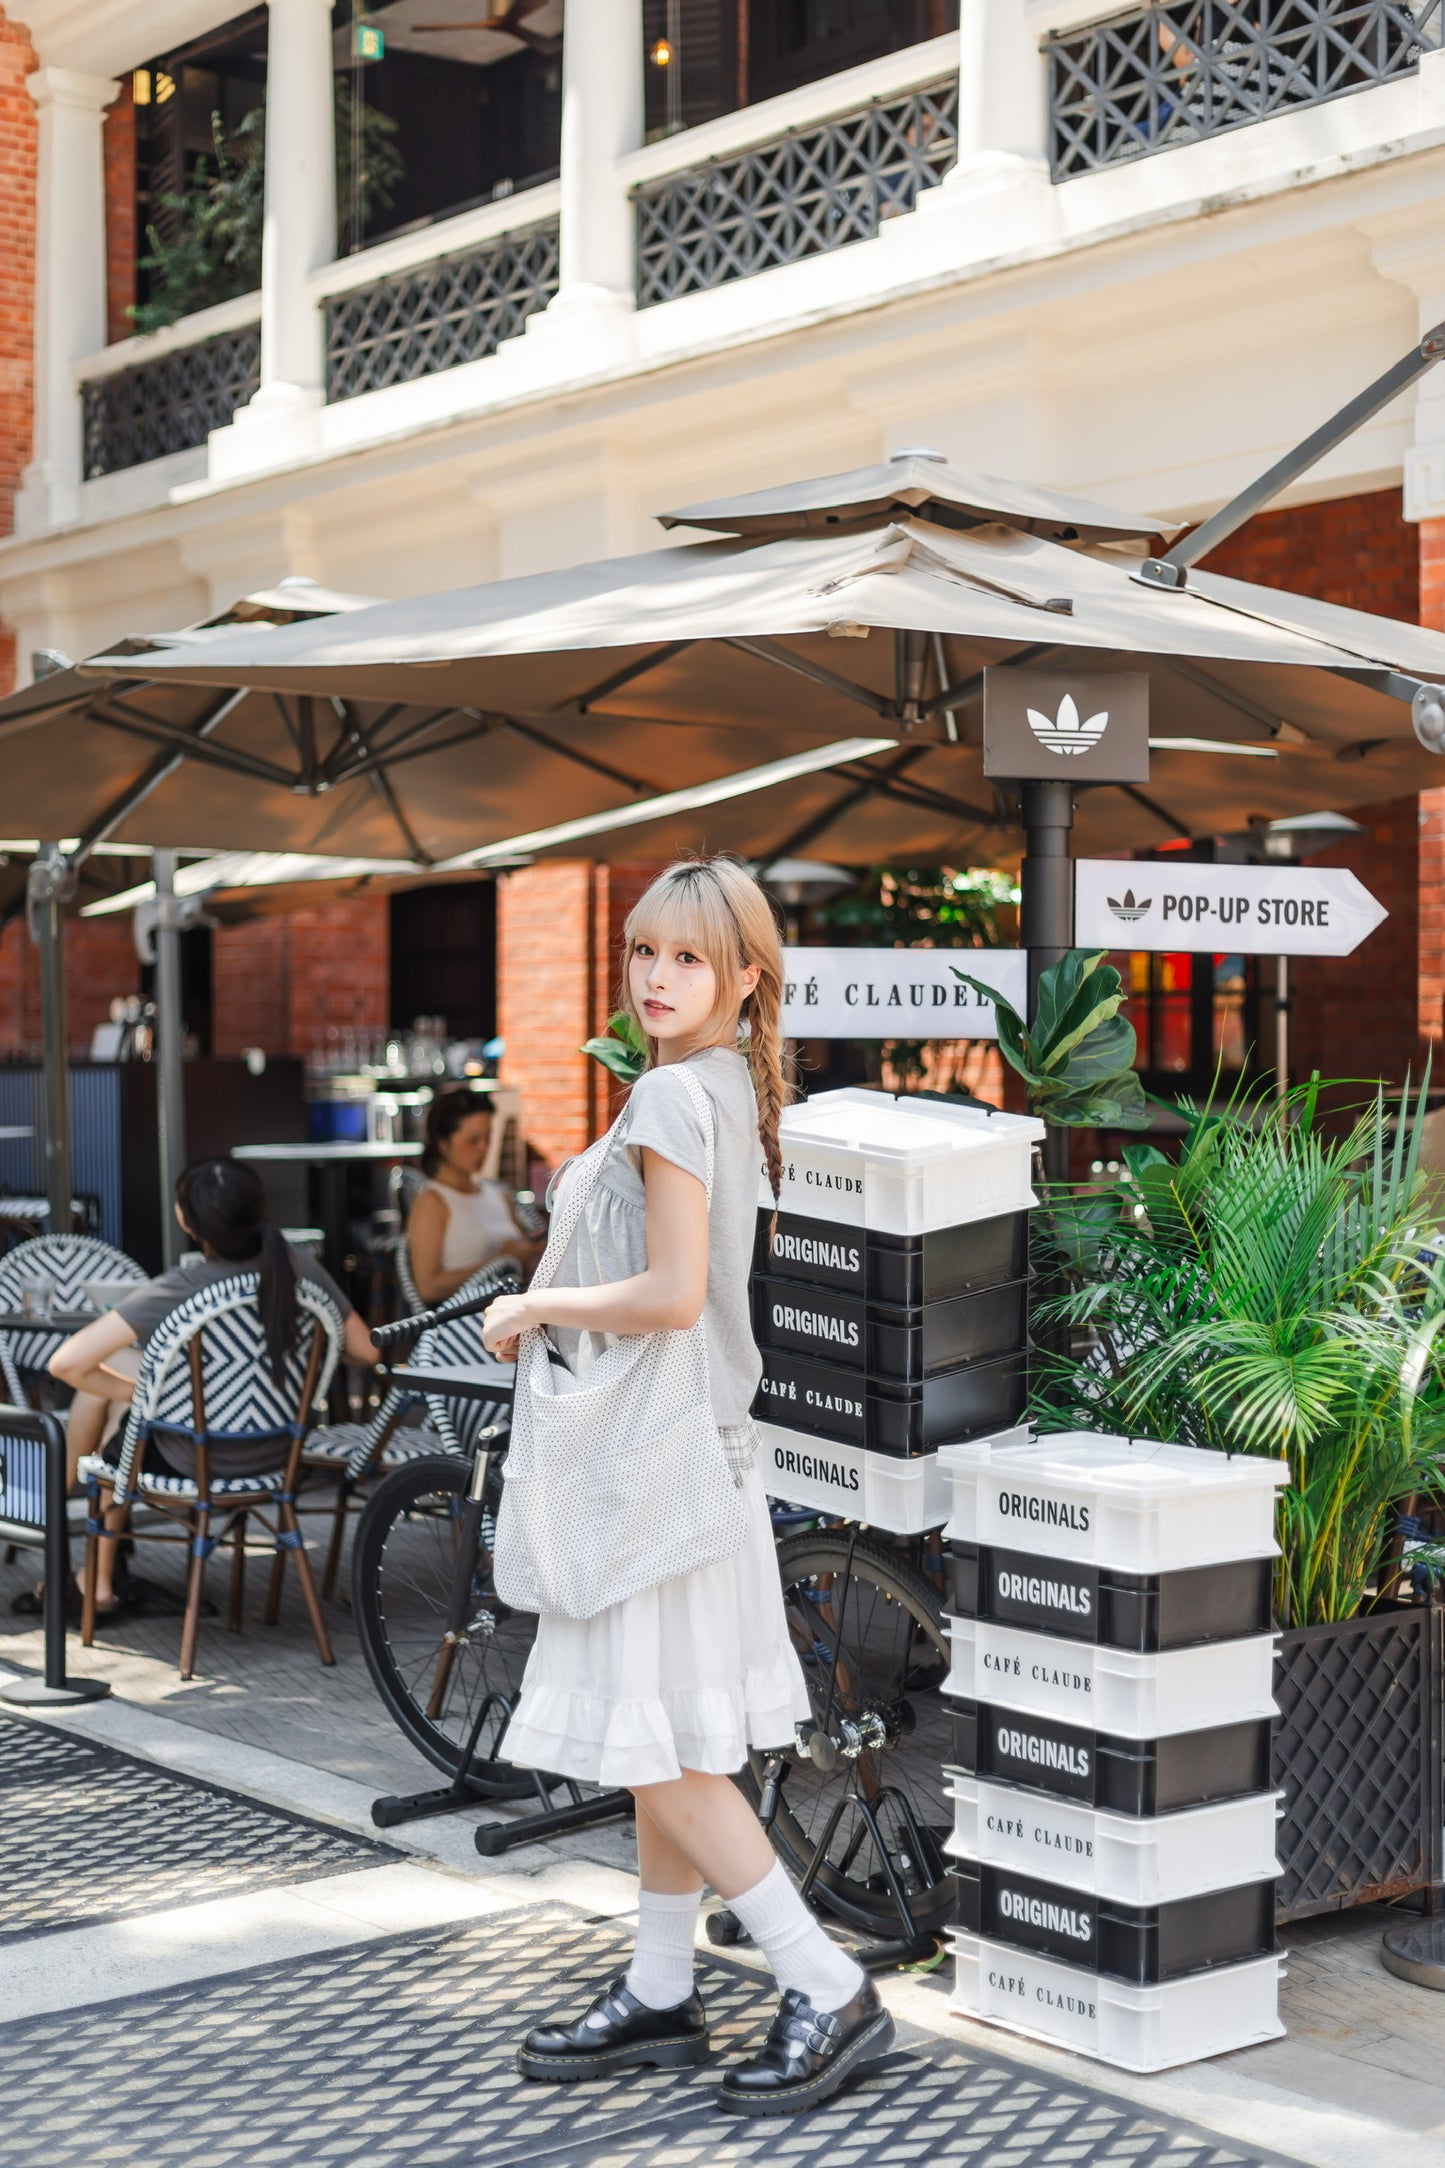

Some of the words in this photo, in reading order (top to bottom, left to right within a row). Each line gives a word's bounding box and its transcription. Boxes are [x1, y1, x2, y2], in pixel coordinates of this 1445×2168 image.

[1163, 895, 1250, 923] POP-UP
[1257, 898, 1329, 926] STORE
[784, 976, 819, 1005] FÉ
[761, 1163, 795, 1181] CÉ
[806, 1171, 863, 1194] CLAUDE
[774, 1233, 860, 1272] ORIGINALS
[772, 1304, 859, 1346] ORIGINALS
[761, 1378, 797, 1400] CAFÉ
[806, 1390, 863, 1417] CLAUDE
[774, 1447, 859, 1491] ORIGINALS
[999, 1491, 1090, 1531] ORIGINALS
[998, 1571, 1091, 1614] ORIGINALS
[984, 1653, 1021, 1676] CAFÉ
[1032, 1665, 1091, 1692] CLAUDE
[997, 1727, 1089, 1777] ORIGINALS
[987, 1816, 1023, 1838] CAFÉ
[1034, 1828, 1093, 1857] CLAUDE
[1000, 1890, 1091, 1941] ORIGINALS
[989, 1972, 1025, 1996] CAFÉ
[1036, 1987, 1096, 2019] CLAUDE
